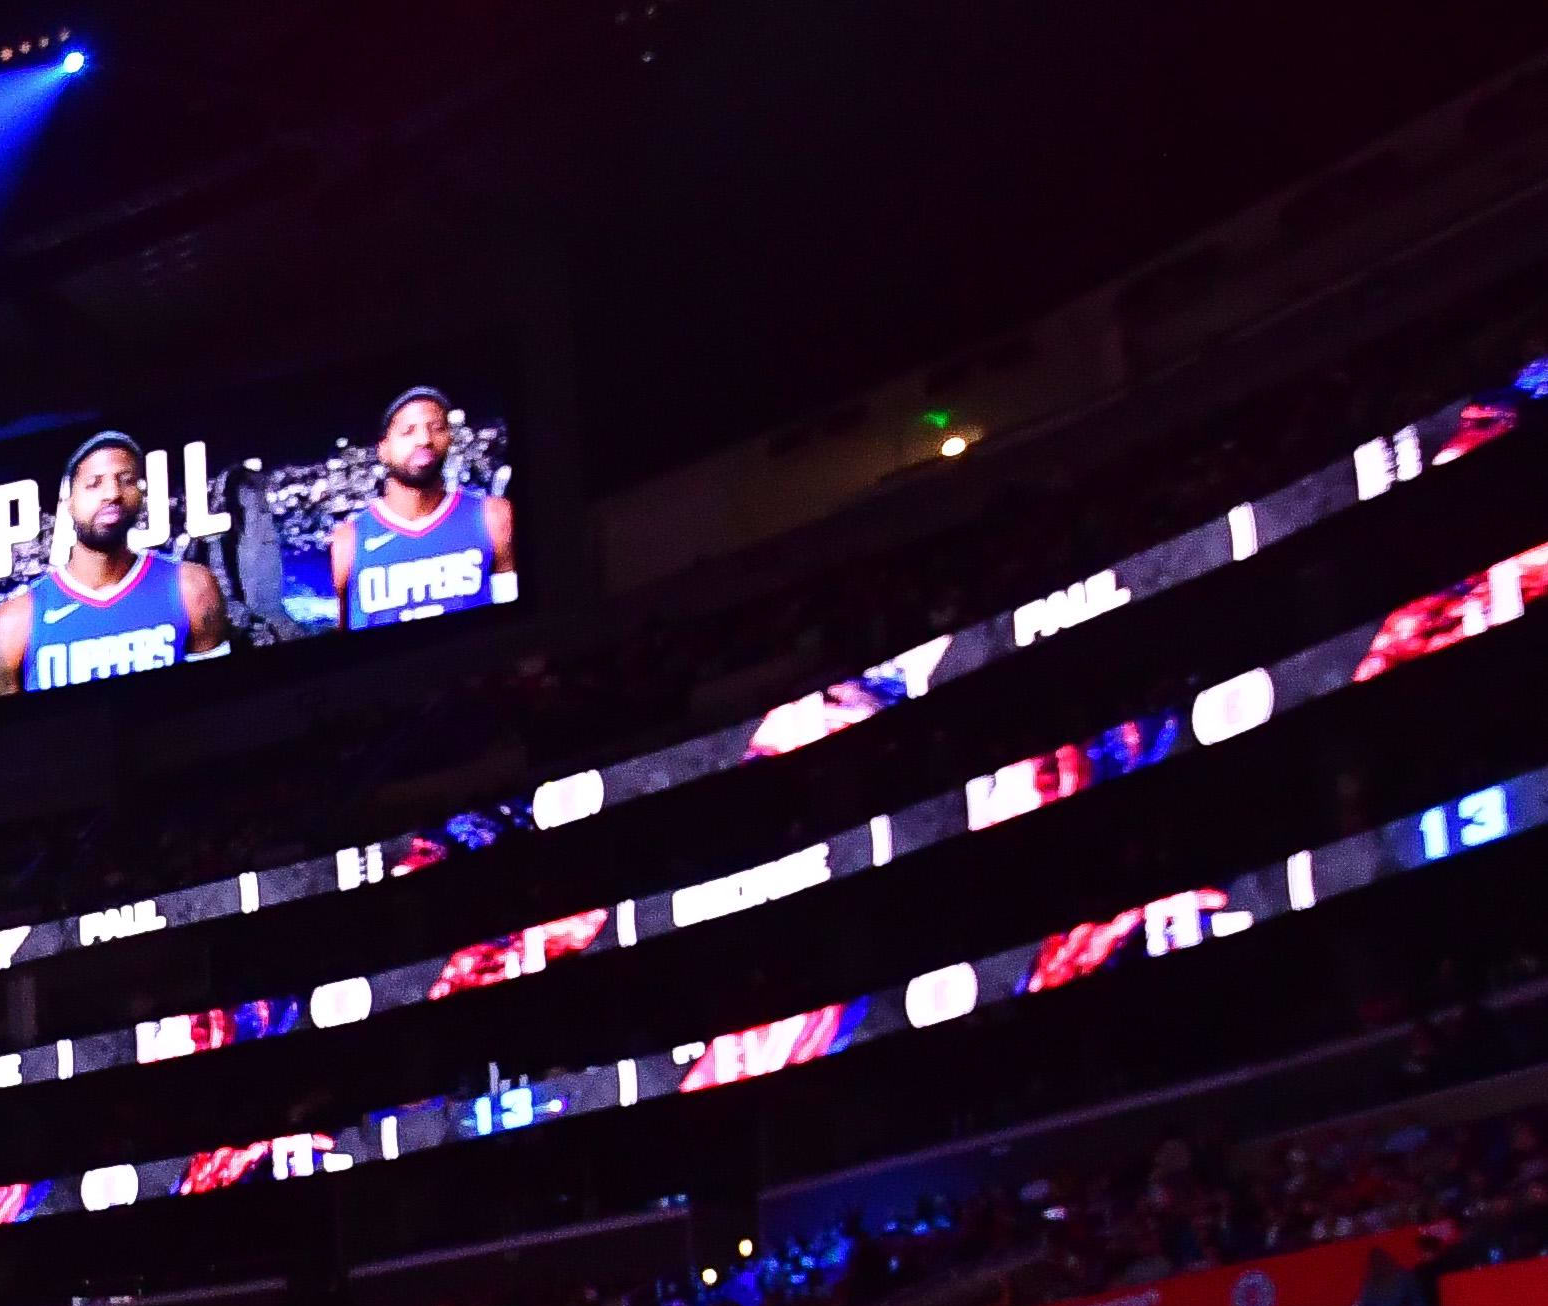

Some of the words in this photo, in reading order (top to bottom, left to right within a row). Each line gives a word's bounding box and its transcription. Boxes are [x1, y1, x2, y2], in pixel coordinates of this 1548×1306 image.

[1014, 569, 1132, 647] PAUL
[1419, 785, 1511, 860] 13
[79, 900, 167, 947] PAUL
[474, 1087, 534, 1136] 13
